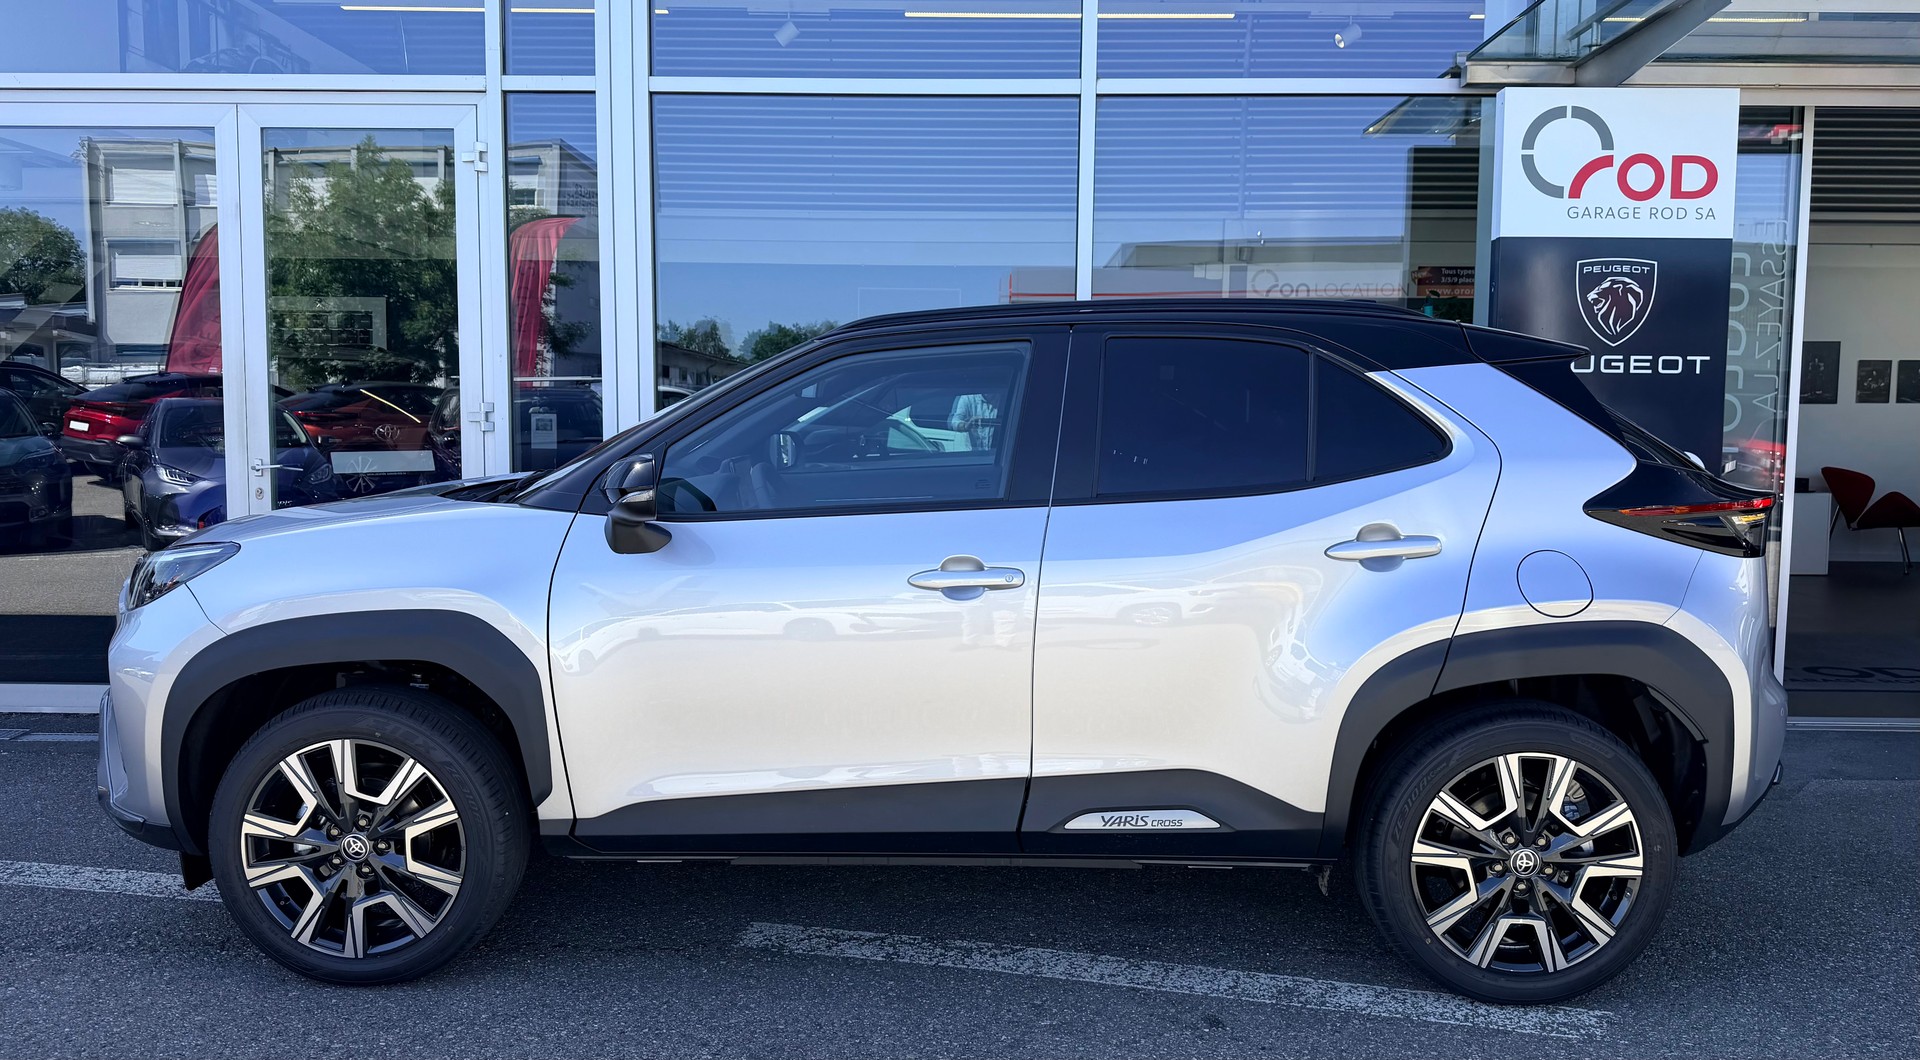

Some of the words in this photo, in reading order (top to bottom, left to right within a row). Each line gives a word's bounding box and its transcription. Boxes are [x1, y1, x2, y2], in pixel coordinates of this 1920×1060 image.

[1567, 206, 1641, 220] GARAGE
[1650, 207, 1687, 220] ROD
[1695, 207, 1716, 220] SA
[1583, 265, 1650, 274] PEUGEOT
[1315, 282, 1409, 297] LOCATION
[1570, 355, 1711, 374] UGEOT
[1151, 819, 1183, 828] CROSS
